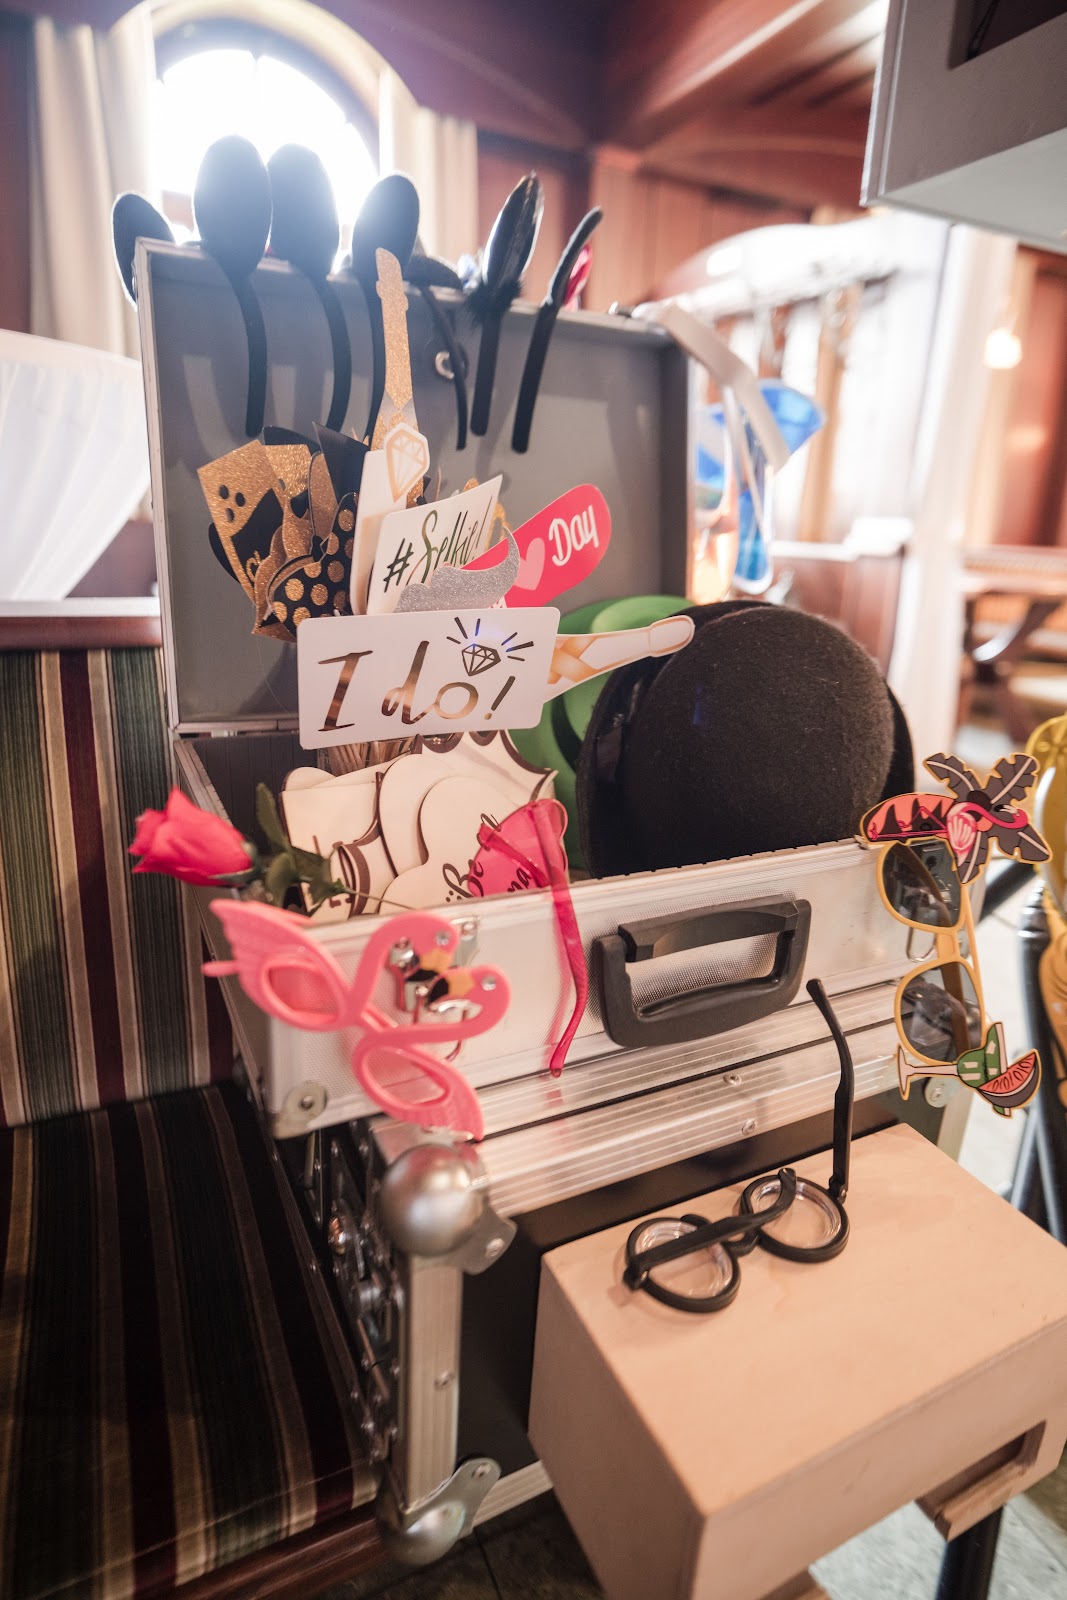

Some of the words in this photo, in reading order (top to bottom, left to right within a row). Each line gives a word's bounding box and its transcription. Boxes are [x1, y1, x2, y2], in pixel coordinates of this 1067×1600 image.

[548, 504, 600, 566] Day
[317, 650, 373, 732] I
[381, 640, 515, 725] do!
